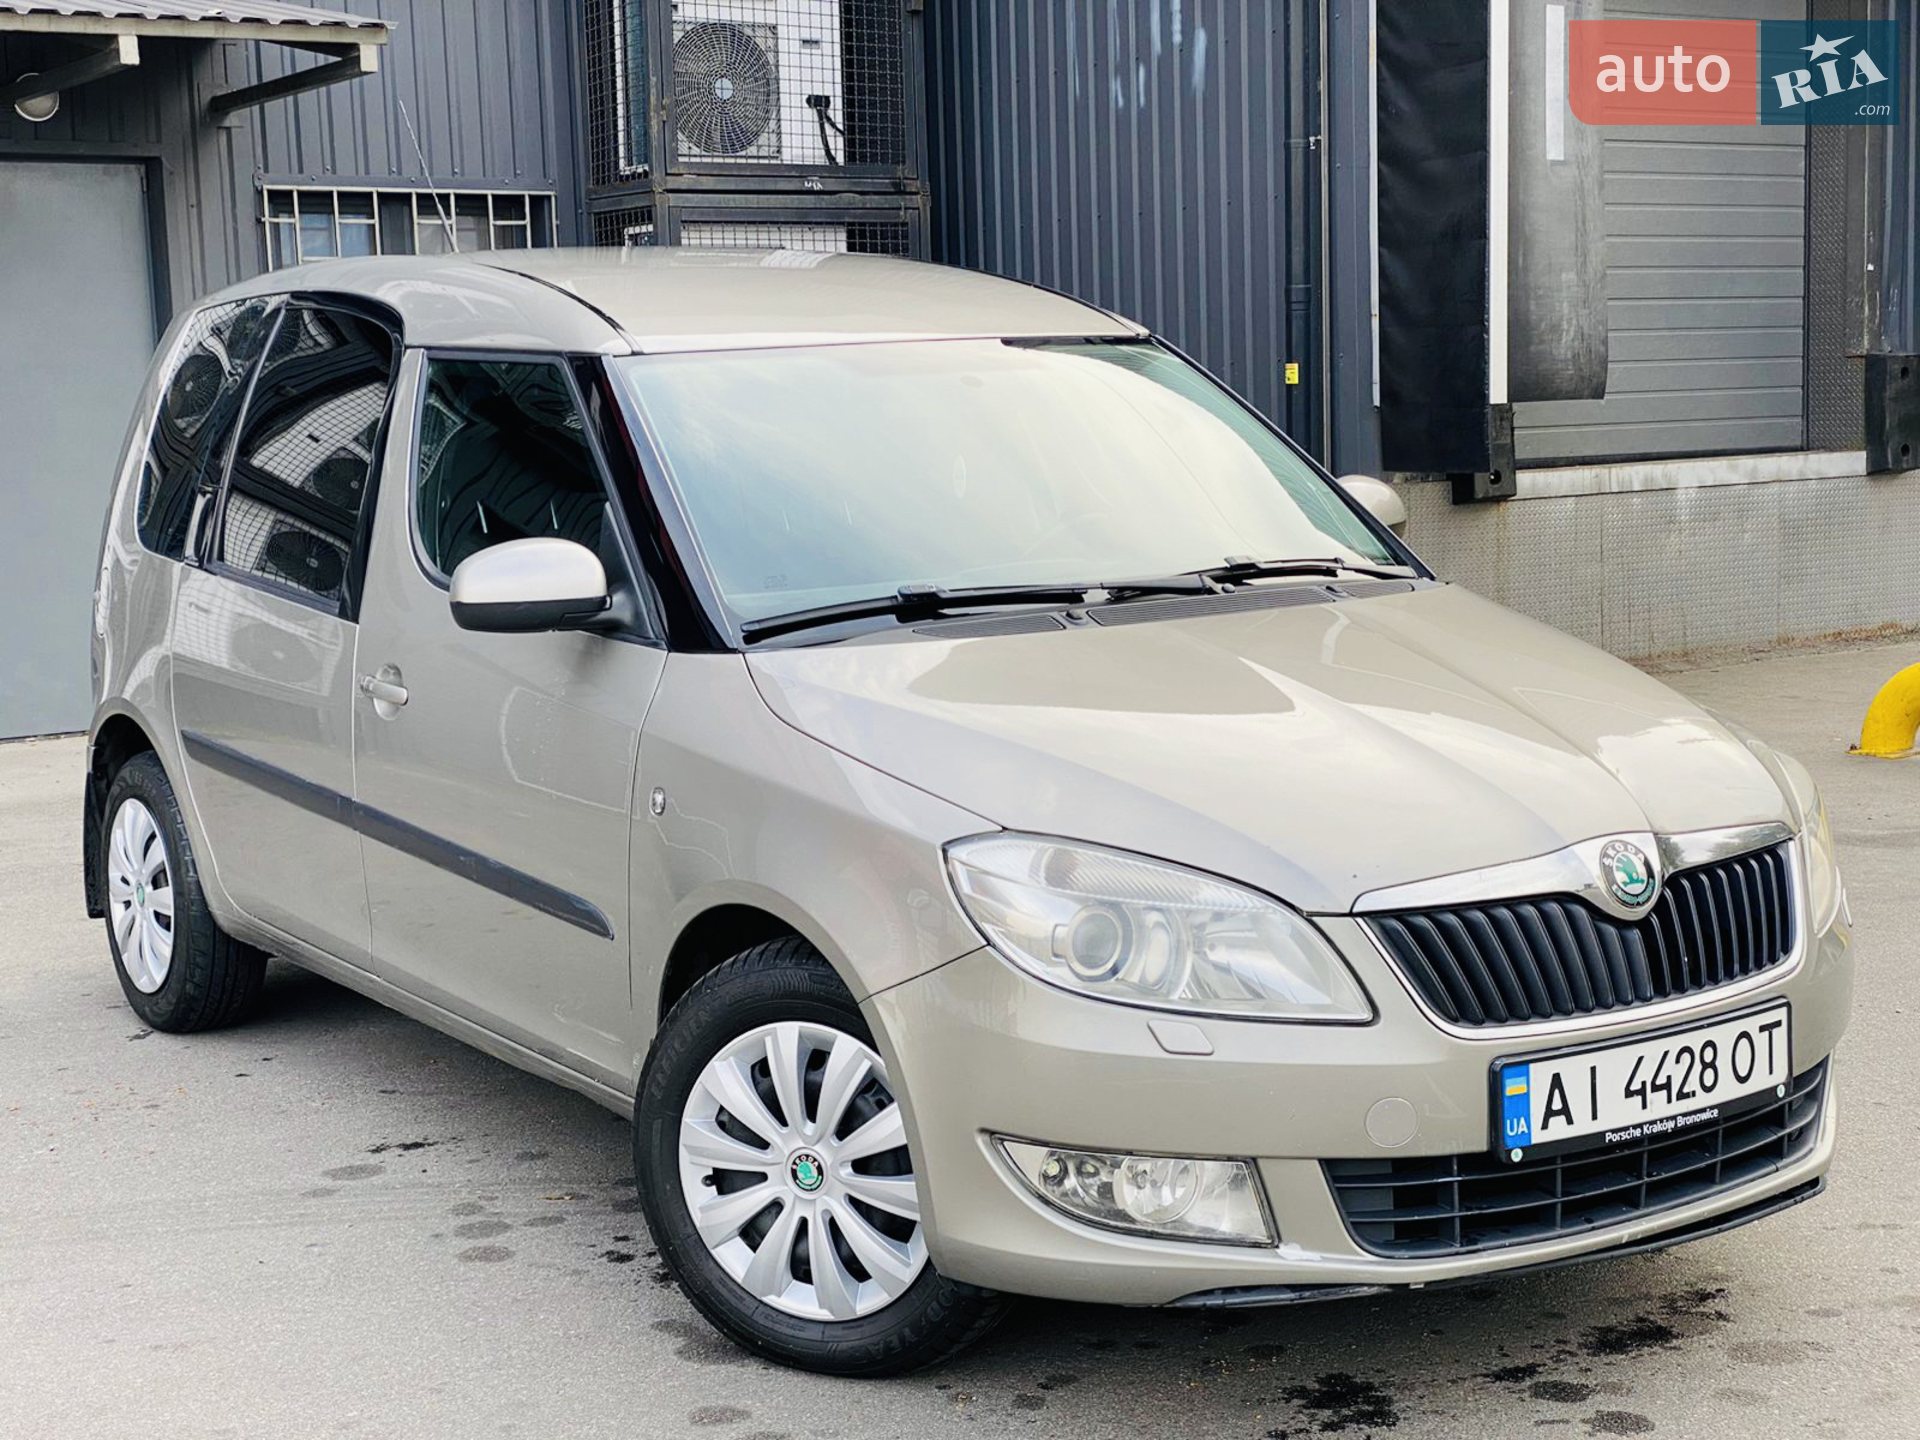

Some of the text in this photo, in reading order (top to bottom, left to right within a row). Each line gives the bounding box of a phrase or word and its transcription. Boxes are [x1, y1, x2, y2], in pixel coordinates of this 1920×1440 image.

[1541, 1019, 1783, 1131] AI 4428 OT
[1507, 1116, 1529, 1136] UA
[1605, 1127, 1642, 1143] Porsche
[1677, 1108, 1719, 1127] Bronowice
